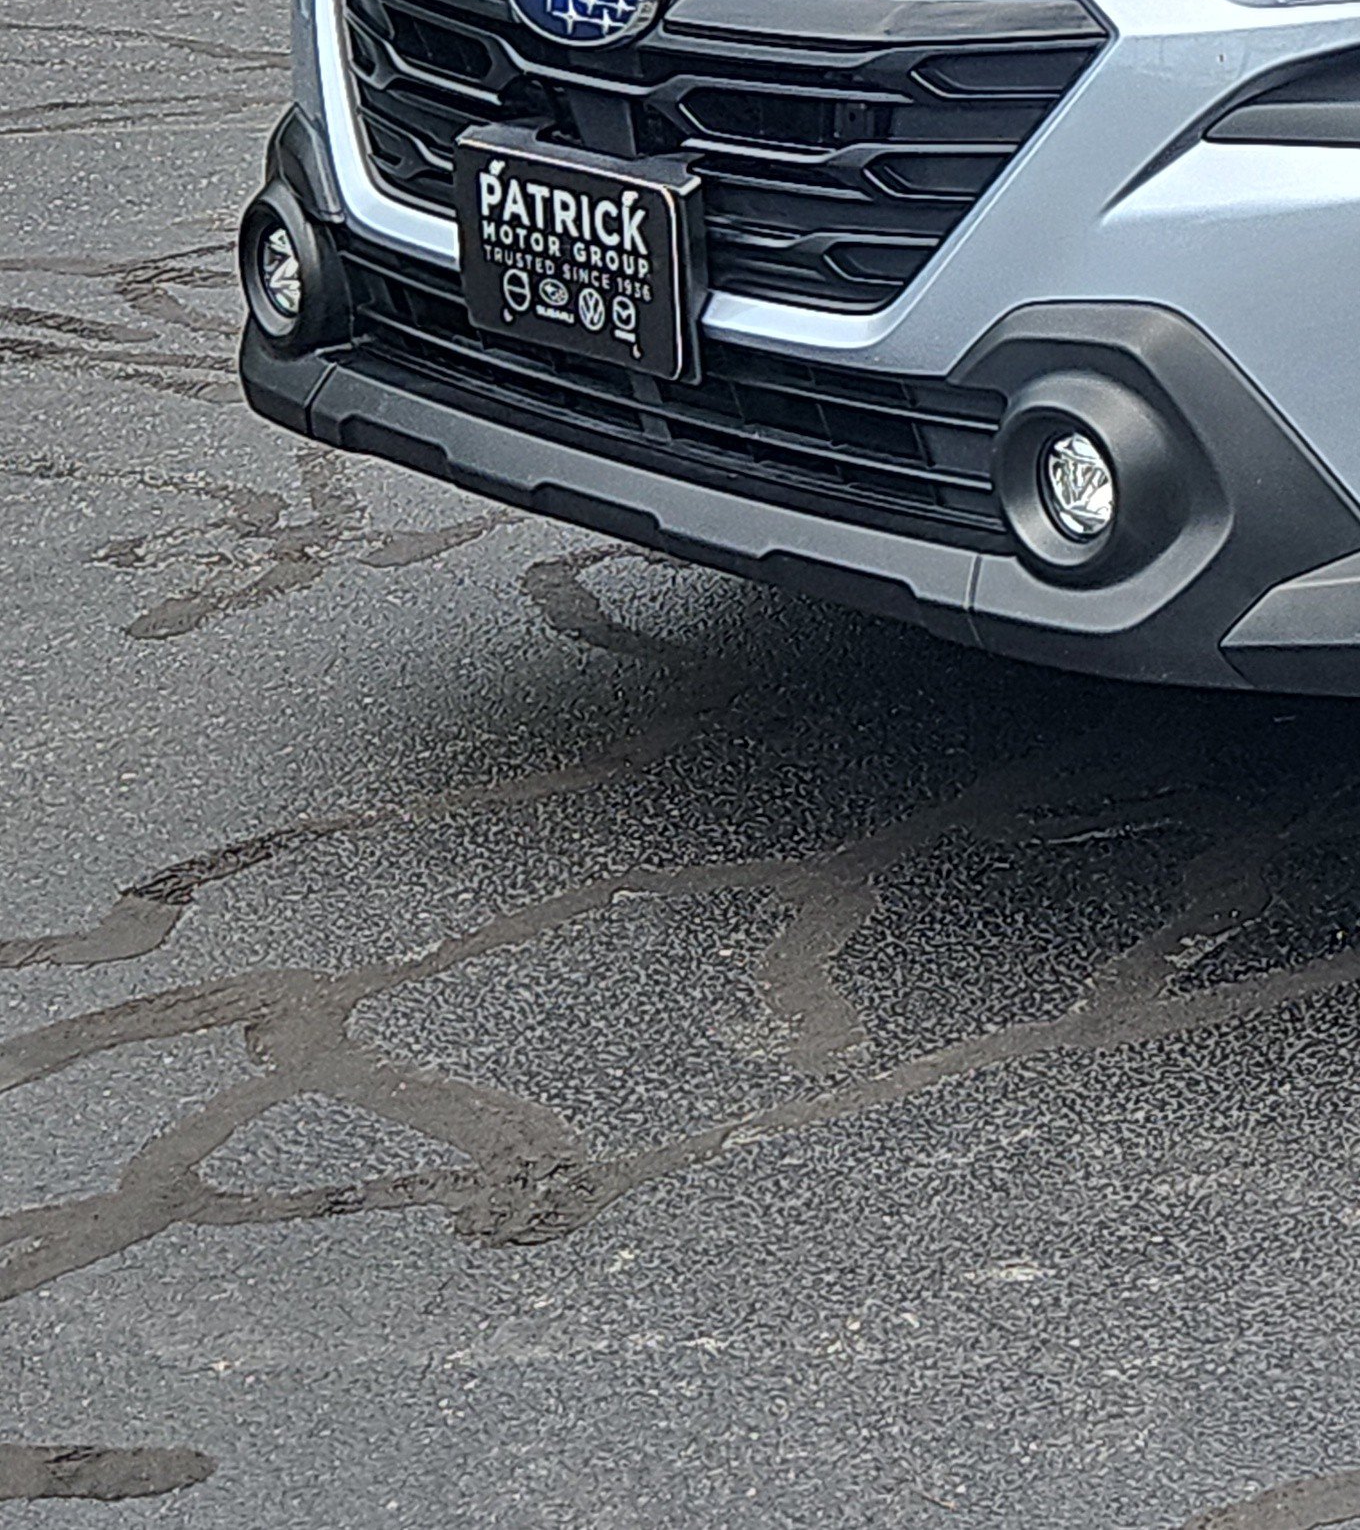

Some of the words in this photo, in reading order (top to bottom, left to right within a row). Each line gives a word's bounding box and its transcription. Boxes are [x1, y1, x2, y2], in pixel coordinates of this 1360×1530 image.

[479, 170, 649, 256] PATRICK
[482, 220, 561, 257] MOTOR
[572, 241, 649, 279] GROUP
[484, 245, 556, 275] TRUSTED
[562, 263, 611, 290] SINCE
[616, 277, 653, 302] 1936
[536, 304, 576, 325] SUBARU
